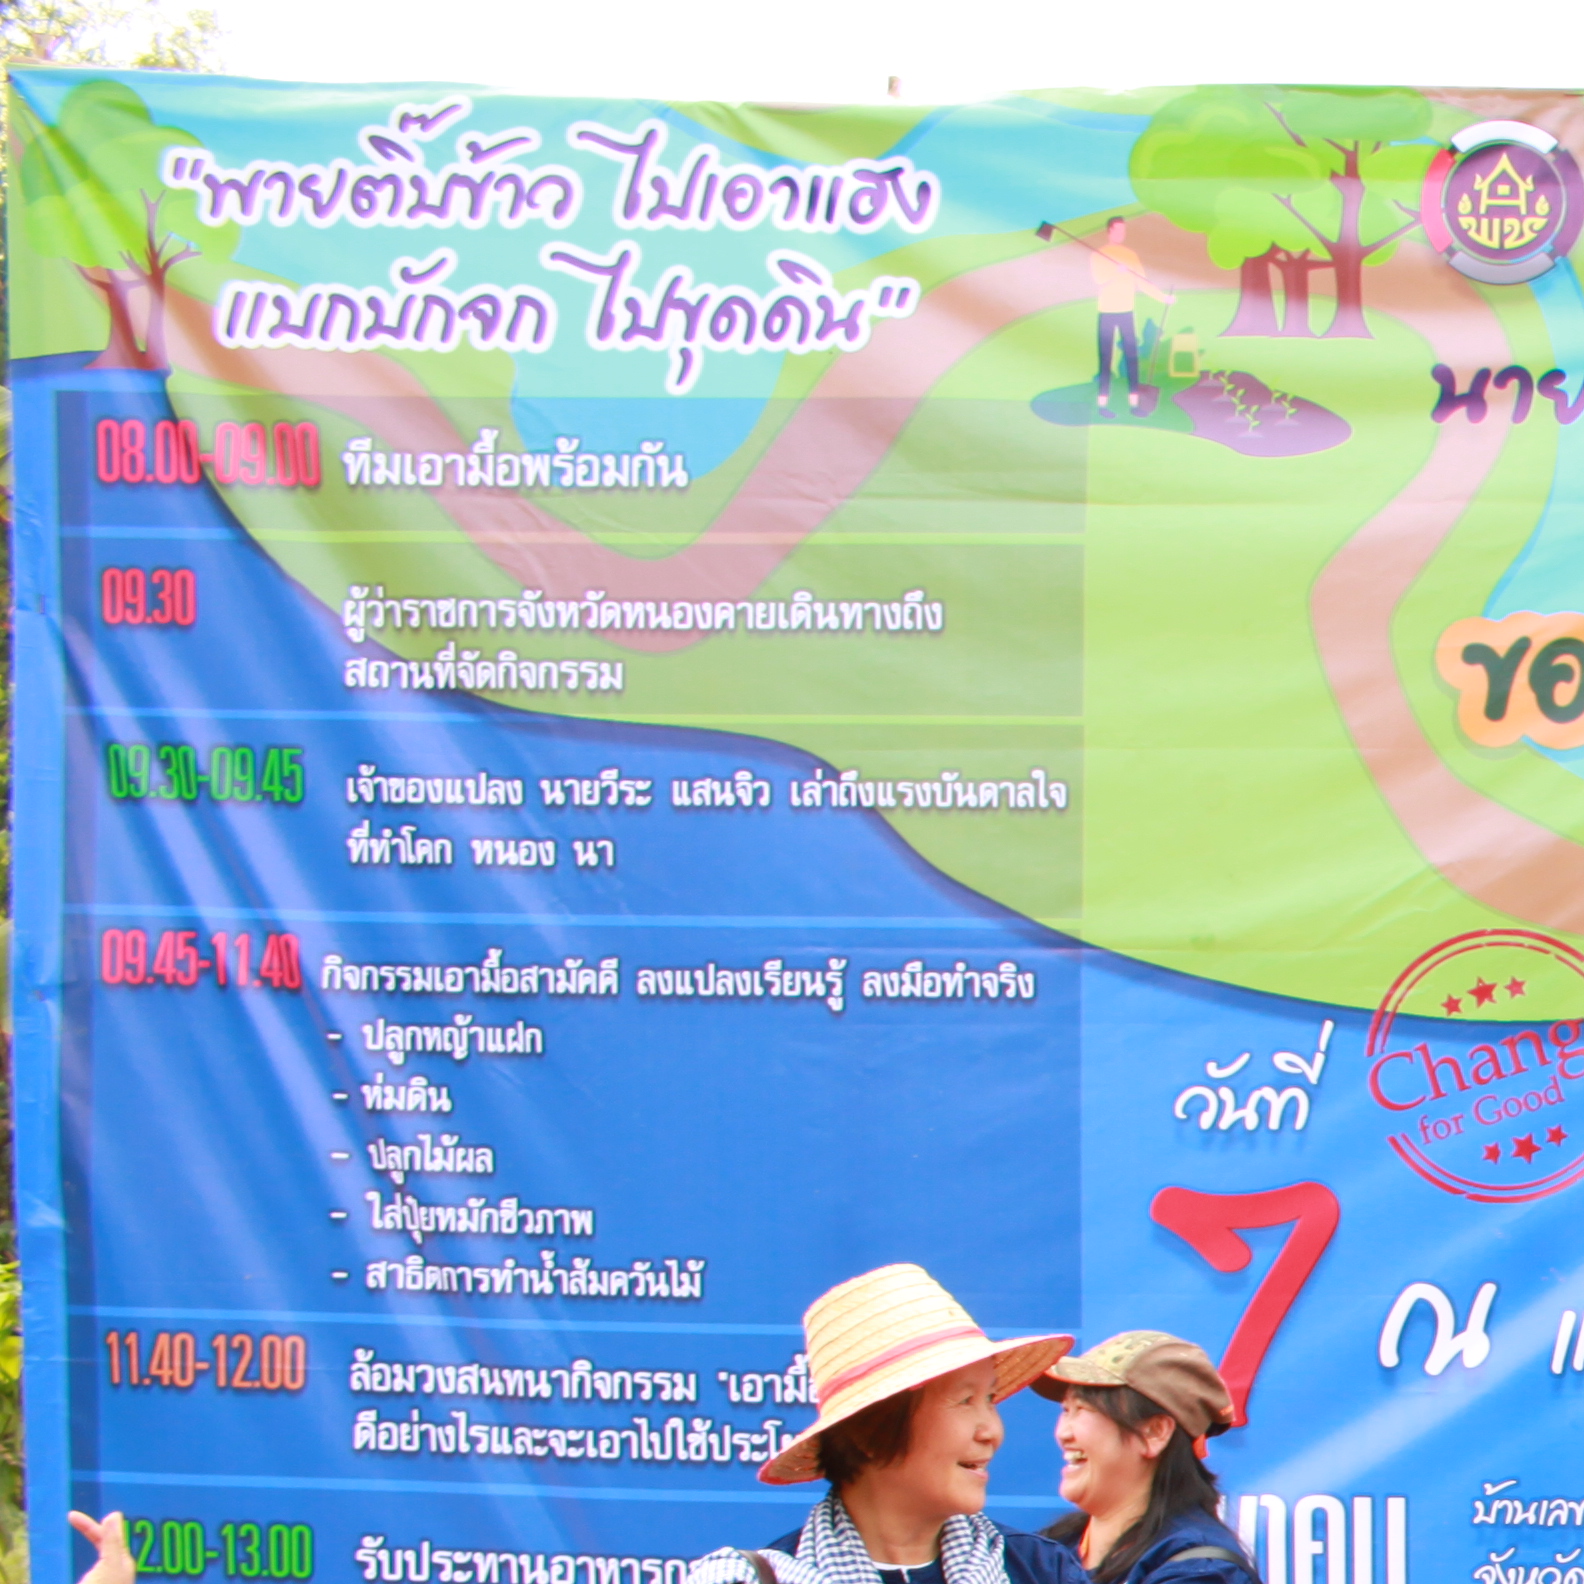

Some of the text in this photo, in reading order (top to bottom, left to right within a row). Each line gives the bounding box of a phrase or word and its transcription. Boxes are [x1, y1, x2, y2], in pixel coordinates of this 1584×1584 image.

[96, 419, 321, 487] 08.00-09.00
[342, 429, 690, 490] ทีมเอามื้อพร้อมกัน
[102, 567, 196, 627] 09.30
[342, 585, 945, 643] ผู้ว่าราชการจังหวัดหนองคายเดินทางถึง
[343, 643, 625, 692] สถานที่จัดกิจกรรม
[107, 743, 304, 804] 09.30-09.45
[345, 764, 1069, 810] เจ้าของแปลง นายวีระ แสนจิว เล่าถึงแรงบันดาลใจ
[346, 821, 616, 869] ที่ทำโคก หนอง นา
[101, 930, 303, 990] 09.45-11.40
[320, 948, 1036, 1012] กิจกรรมเอามื้อสามัคคี ลงแปลงเรียนรู้ ลงมือทำจริง
[361, 1013, 544, 1065] ปลูกหญ้าแฝก
[1174, 1021, 1335, 1135] วันที่
[1418, 1074, 1567, 1145] for Good
[366, 1133, 495, 1184] ปลูกไม้ผล
[365, 1193, 595, 1244] ใส่ปุ๋ยหมักชีวภาพ
[365, 1251, 706, 1300] สาธิตการทำน้ำส้มควันไม้
[1150, 1180, 1341, 1428] 7
[1379, 1280, 1499, 1377] ณ
[105, 1331, 307, 1391] 11.40-12.00
[349, 1348, 698, 1403] ล้อมวงสนทนากิจกรรม
